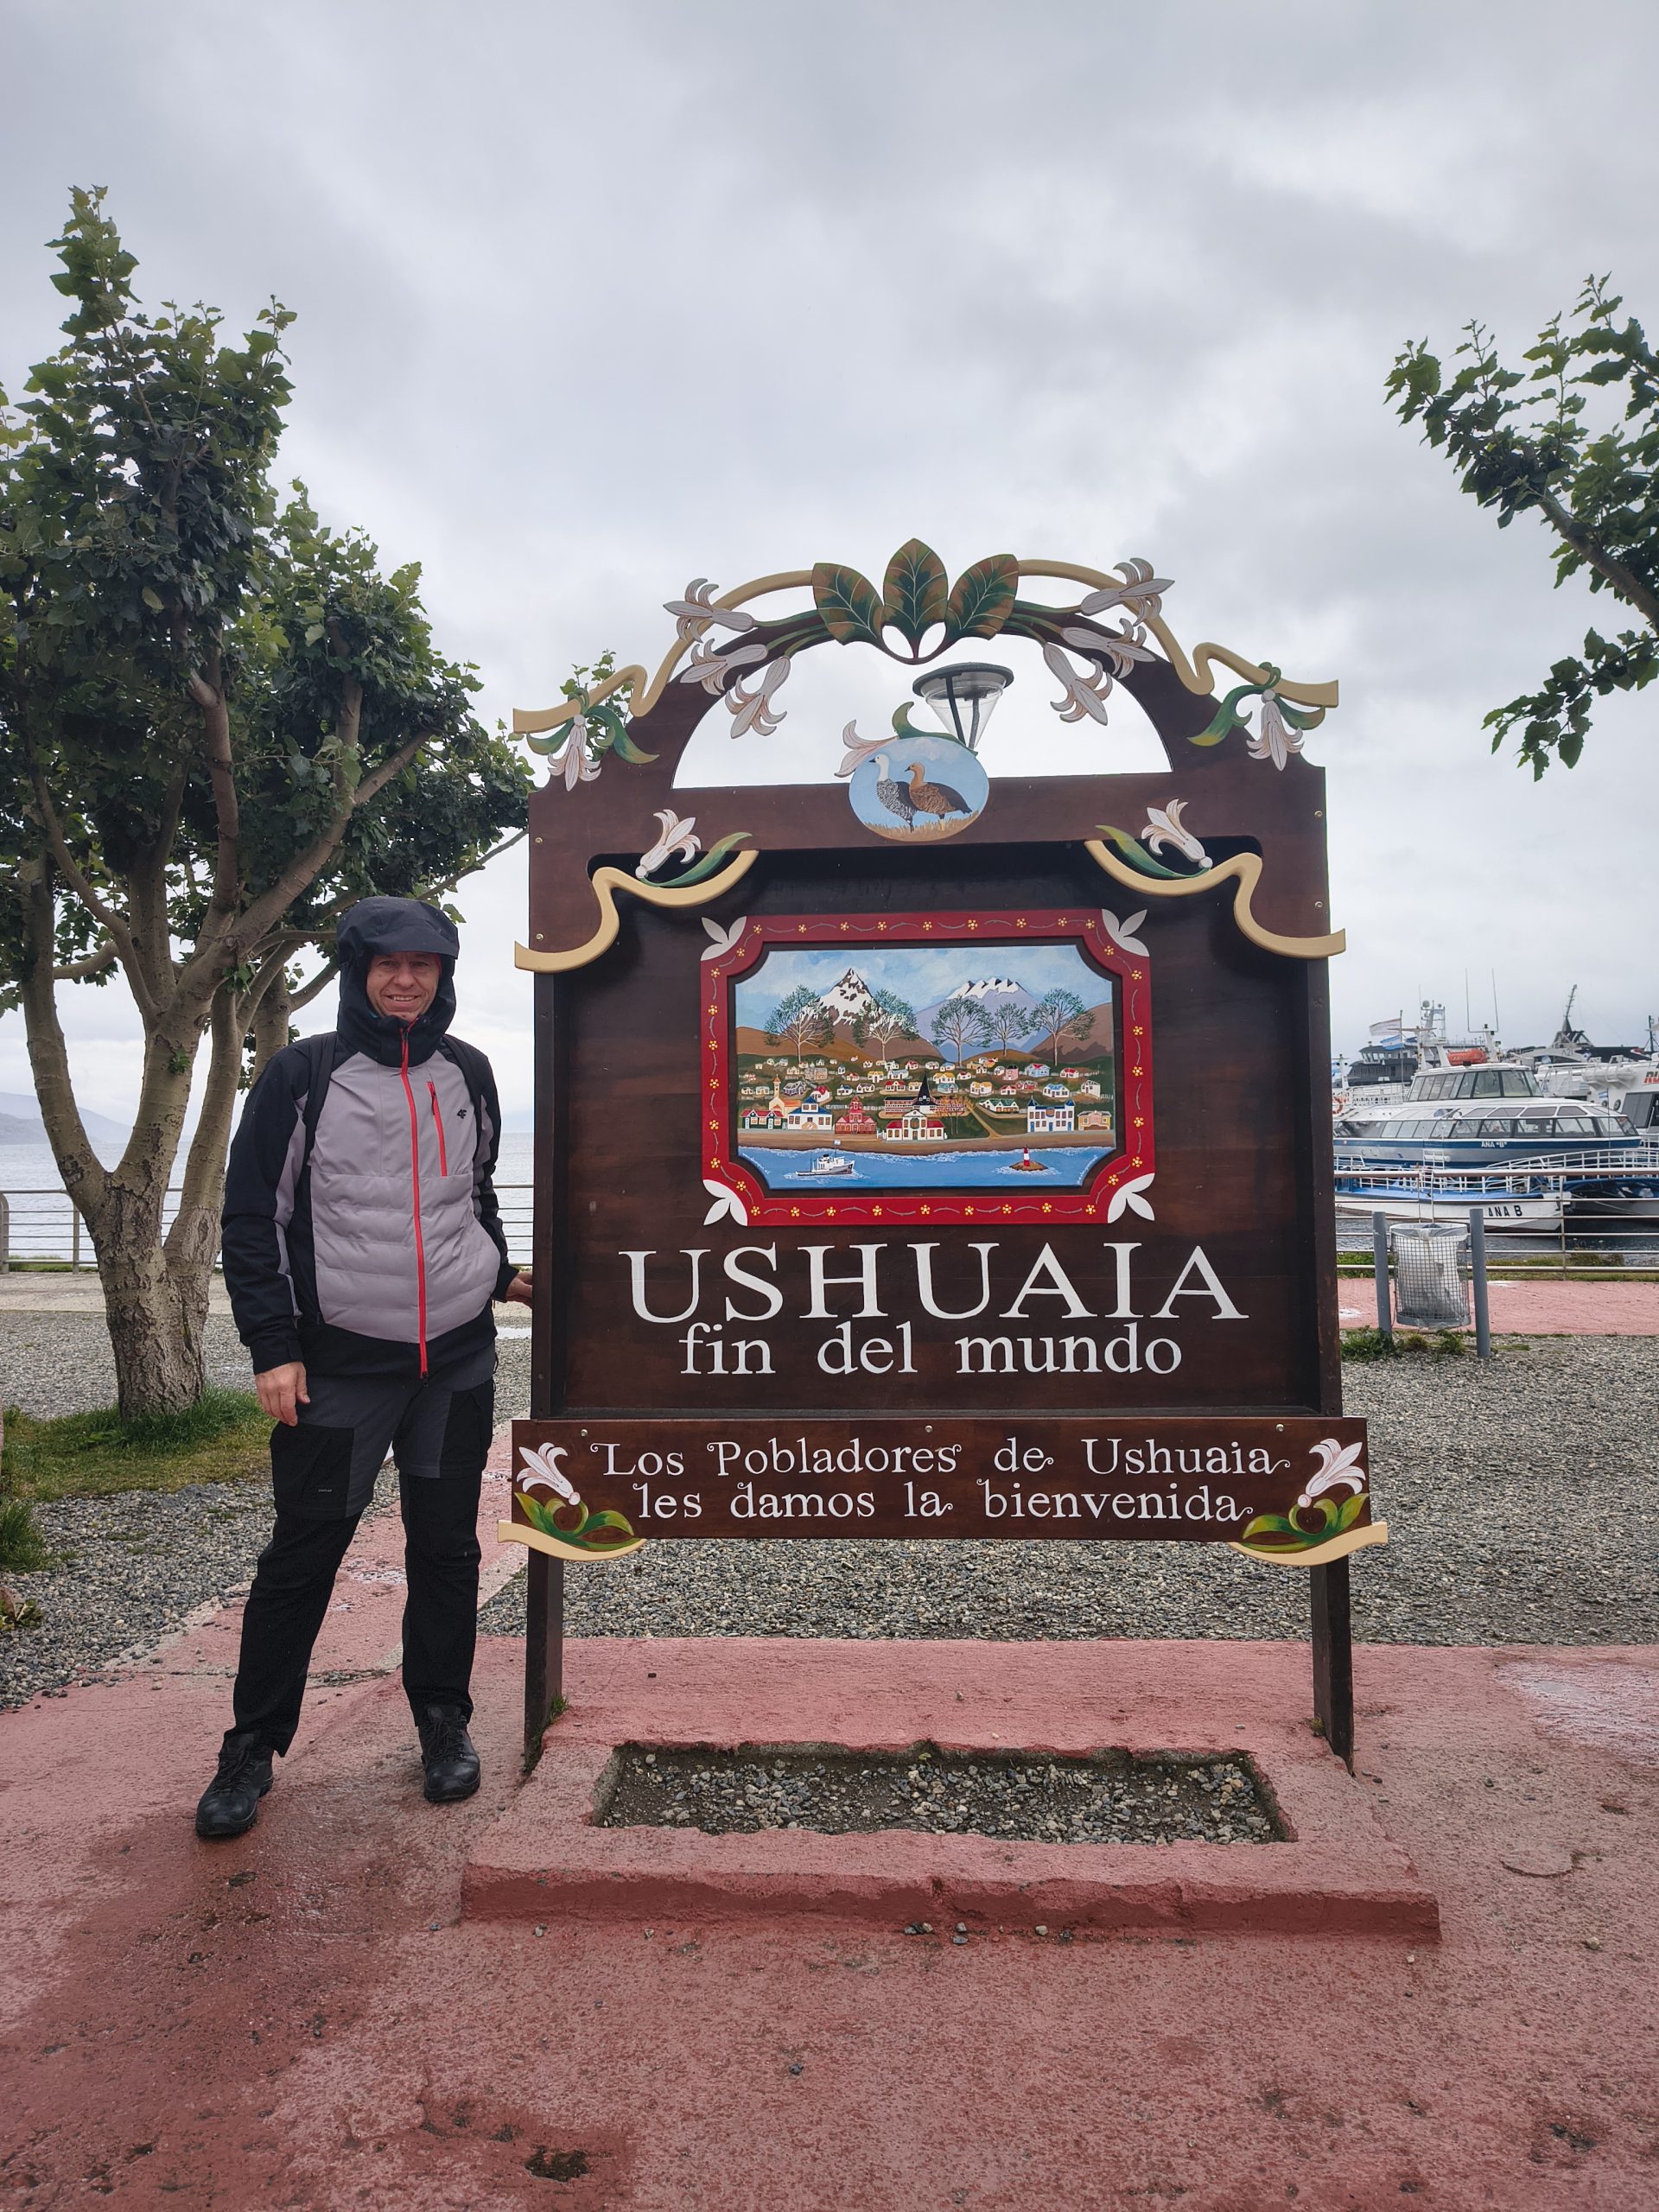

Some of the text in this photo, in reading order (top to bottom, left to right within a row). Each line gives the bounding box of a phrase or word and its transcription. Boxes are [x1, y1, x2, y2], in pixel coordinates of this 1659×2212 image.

[456, 1109, 467, 1119] 4F
[1488, 1205, 1523, 1217] ANA B
[619, 1243, 1249, 1324] USHUAIA
[678, 1321, 1182, 1375] fin del mundo
[590, 1436, 1291, 1477] Los Pobladores de Ushuaia
[632, 1478, 1254, 1522] les damos la bienvenida
